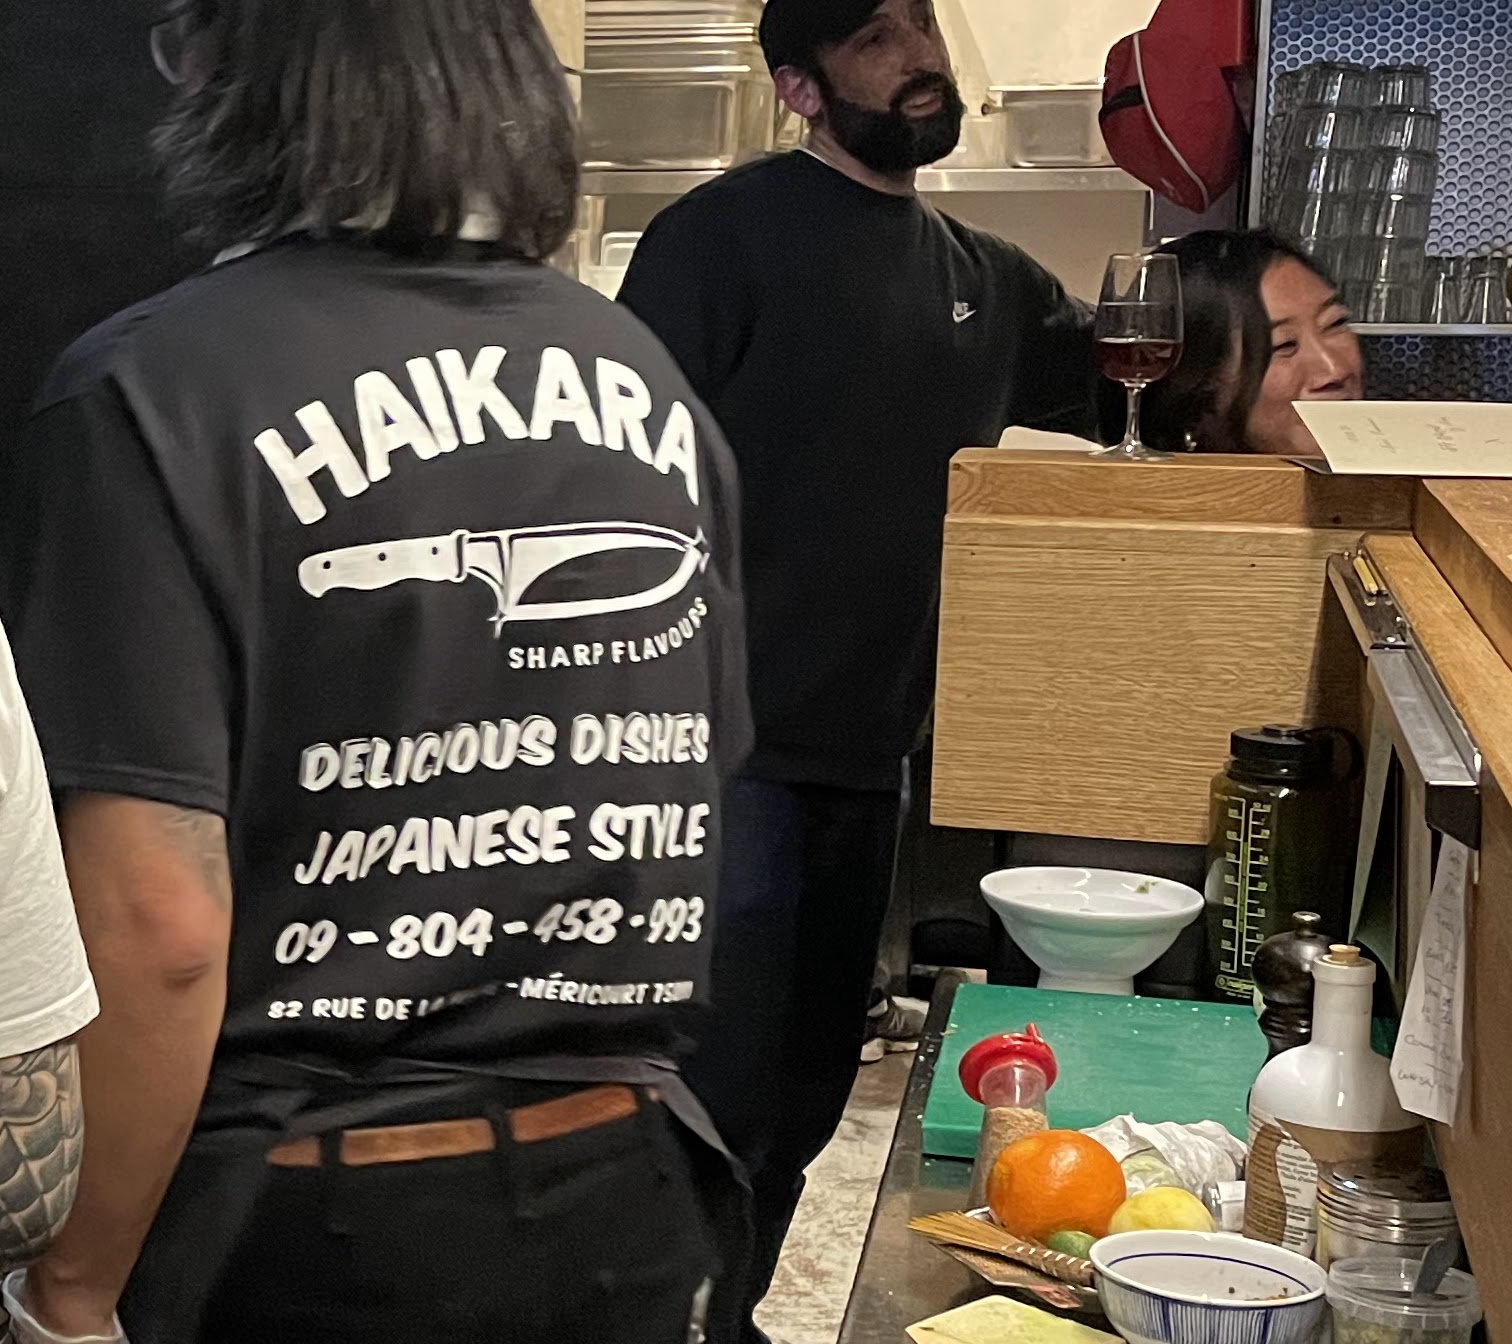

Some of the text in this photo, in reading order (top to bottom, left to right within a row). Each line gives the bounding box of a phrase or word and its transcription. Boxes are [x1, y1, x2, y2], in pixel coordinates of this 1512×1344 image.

[253, 345, 699, 525] HAIKARA
[508, 641, 605, 671] SHARP
[299, 711, 710, 792] DELICIOUS DISHES
[294, 802, 710, 885] JAPANESE STYLE
[311, 996, 367, 1019] RUE
[375, 997, 414, 1022] DE
